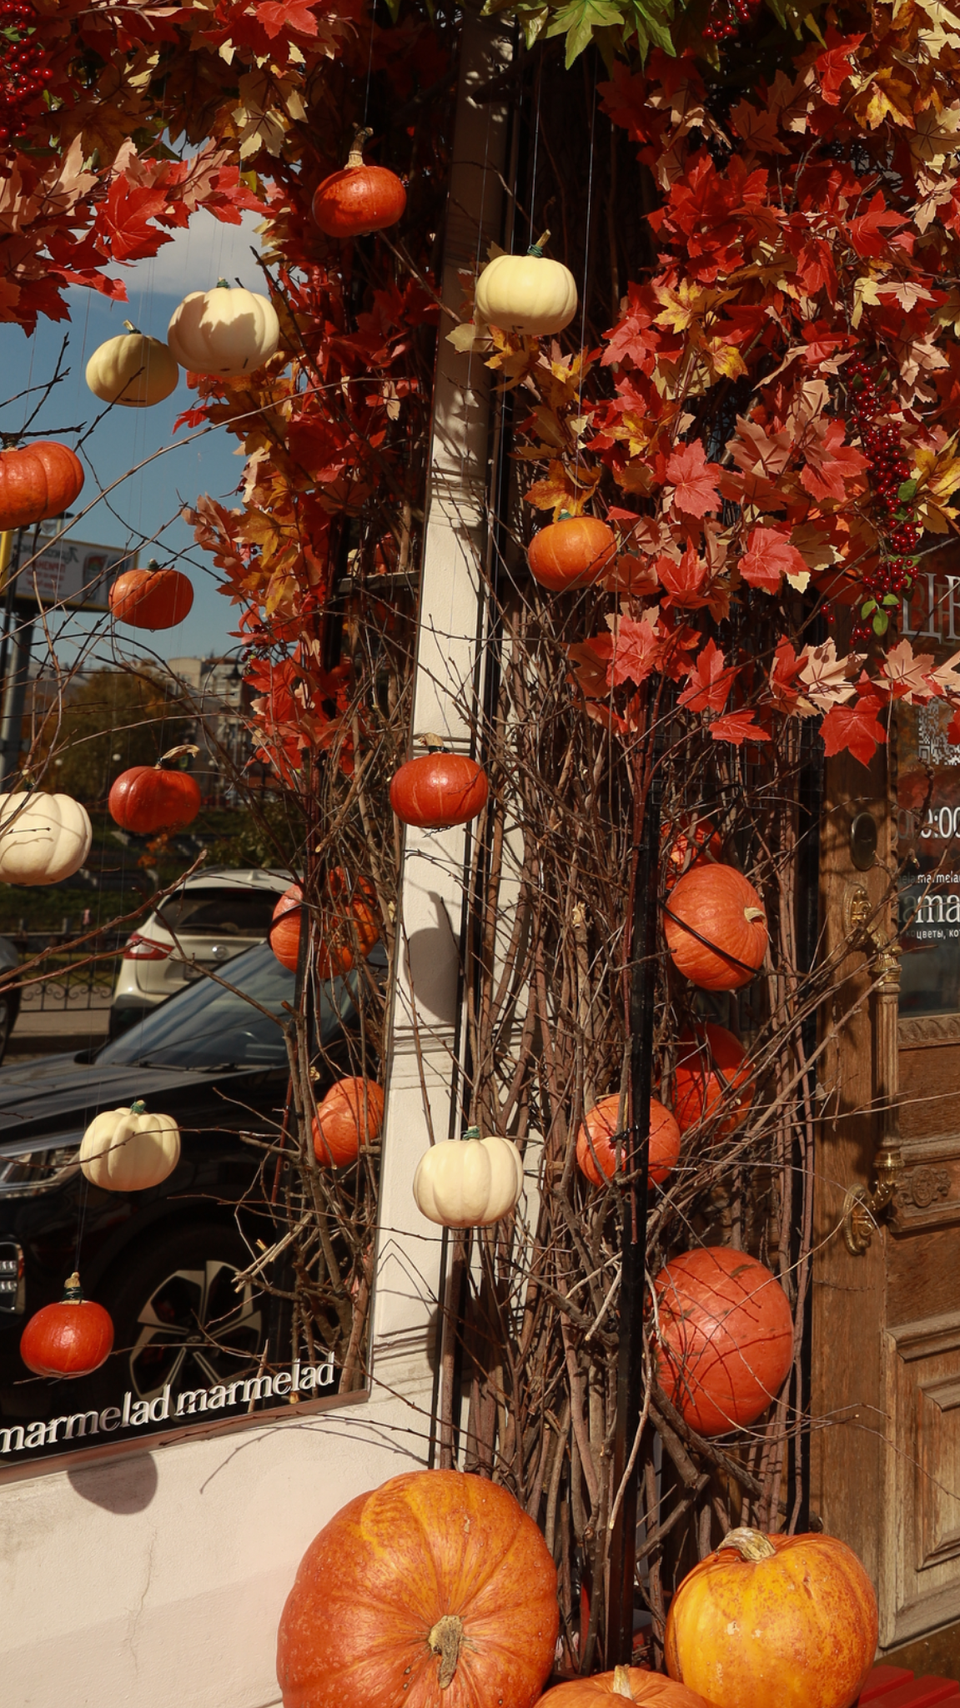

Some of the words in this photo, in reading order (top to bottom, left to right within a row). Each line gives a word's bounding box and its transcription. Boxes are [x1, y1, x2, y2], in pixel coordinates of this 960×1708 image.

[916, 928, 947, 941] цветы,
[0, 1384, 171, 1453] marmelad
[174, 1351, 335, 1416] marmelad
